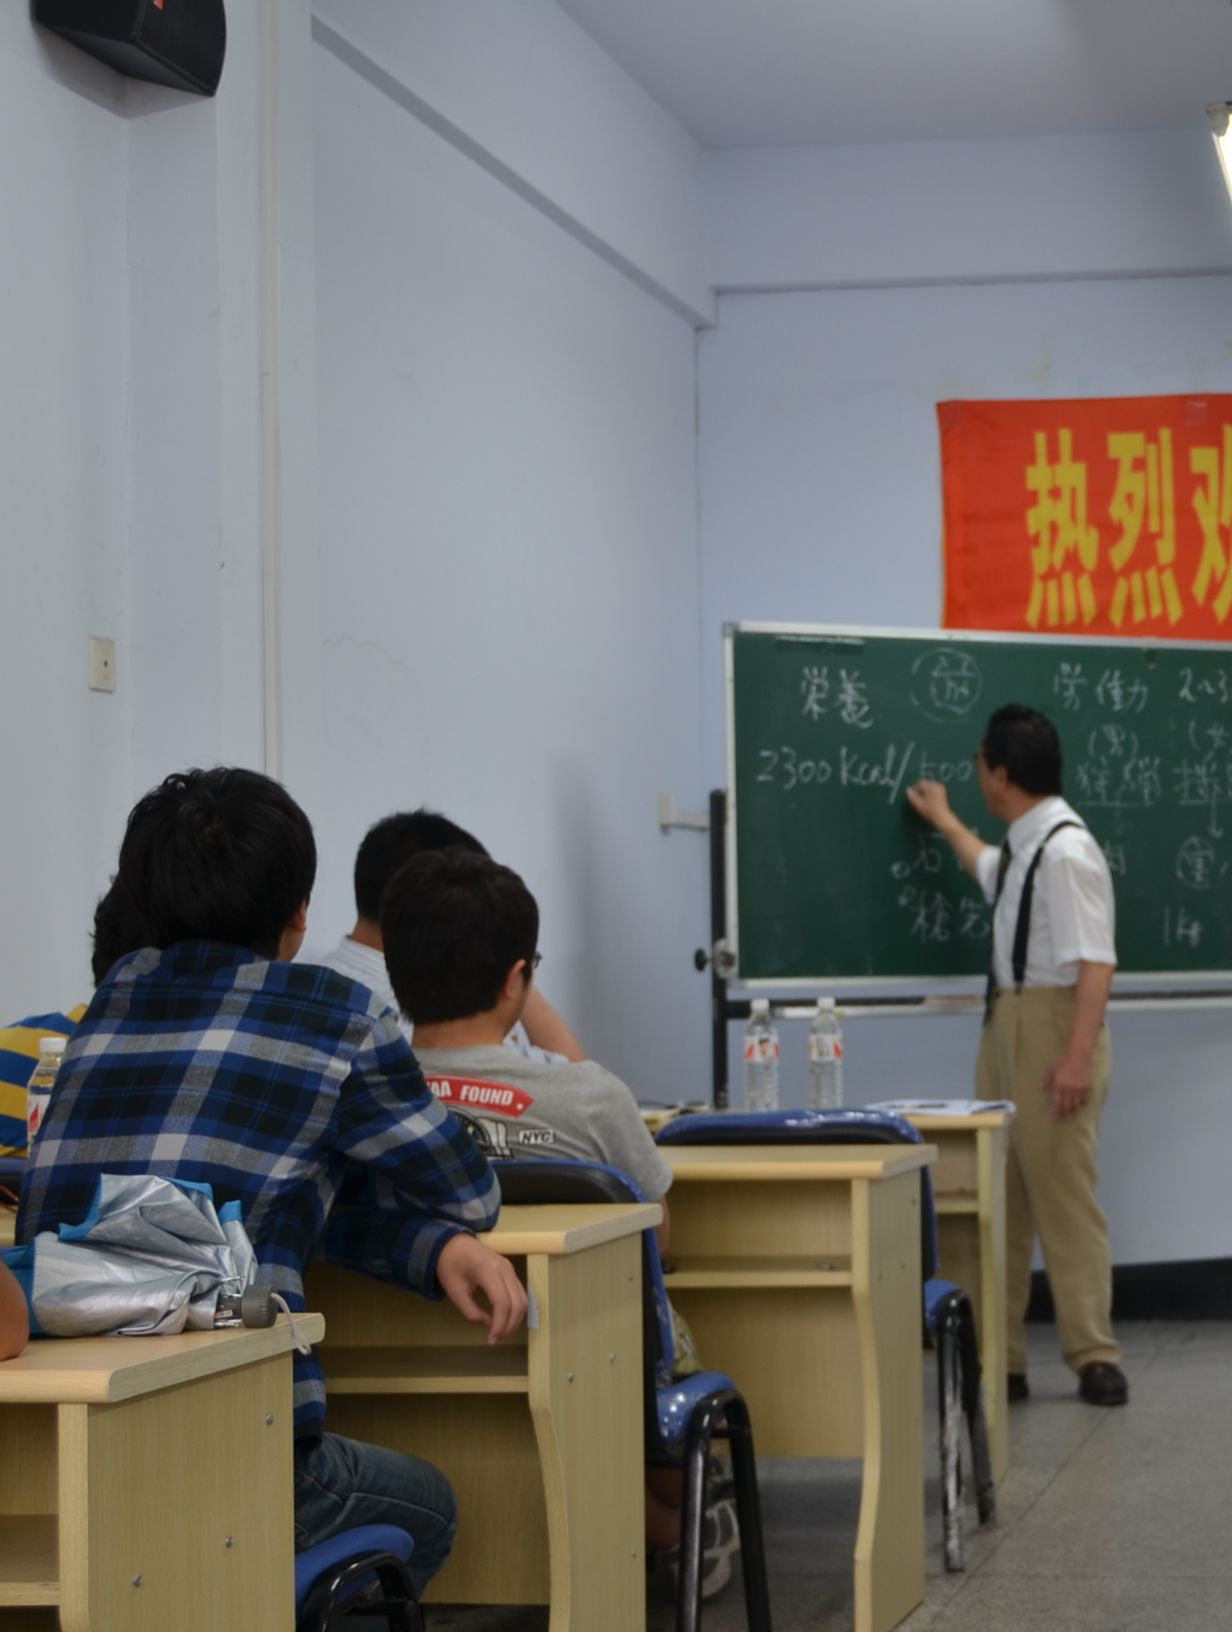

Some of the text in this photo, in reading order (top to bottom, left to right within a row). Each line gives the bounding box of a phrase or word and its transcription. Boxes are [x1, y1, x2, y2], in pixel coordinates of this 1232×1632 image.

[426, 1080, 514, 1106] AA FOUND
[521, 1130, 551, 1145] NYC
